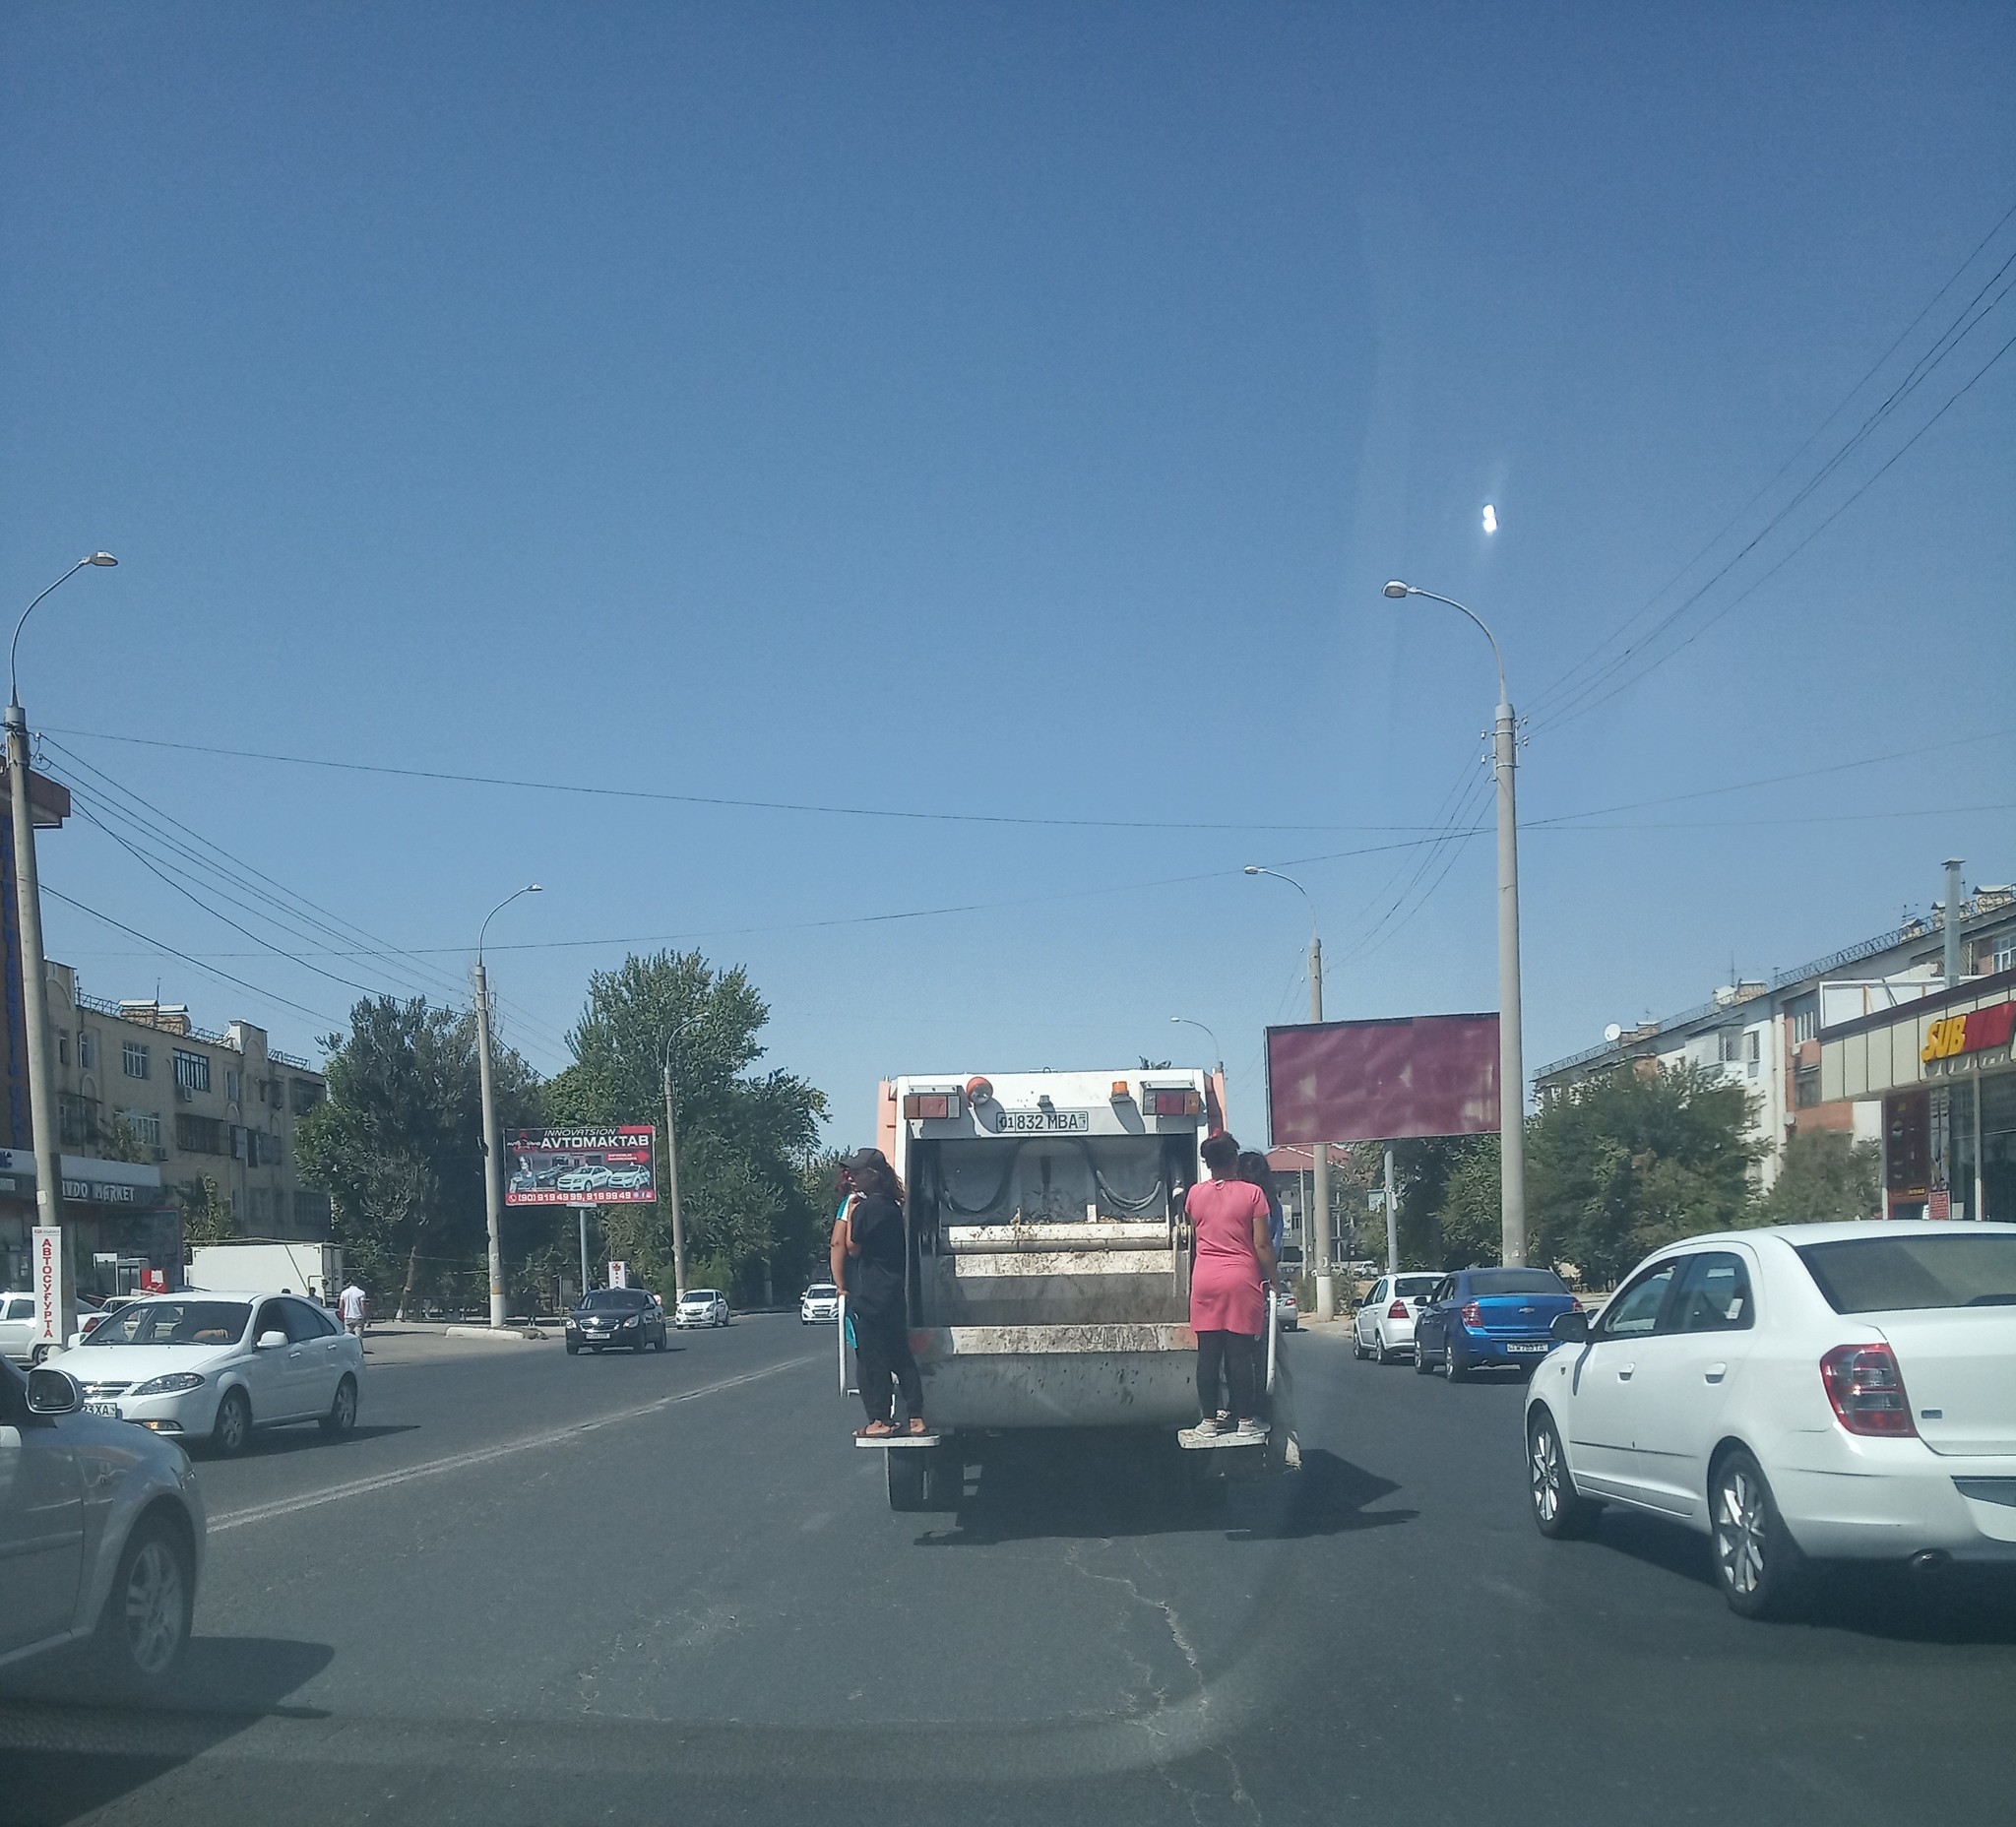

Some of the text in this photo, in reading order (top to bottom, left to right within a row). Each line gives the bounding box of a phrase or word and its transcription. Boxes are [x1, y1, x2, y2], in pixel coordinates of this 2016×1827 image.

[1921, 1015, 1967, 1063] SUB
[999, 1116, 1014, 1128] 01
[1017, 1114, 1043, 1129] 832
[1047, 1114, 1078, 1129] MBA
[544, 1128, 616, 1137] INNOVATSION
[540, 1135, 650, 1149] AVTOMAKTAB
[93, 1182, 135, 1202] MARKET
